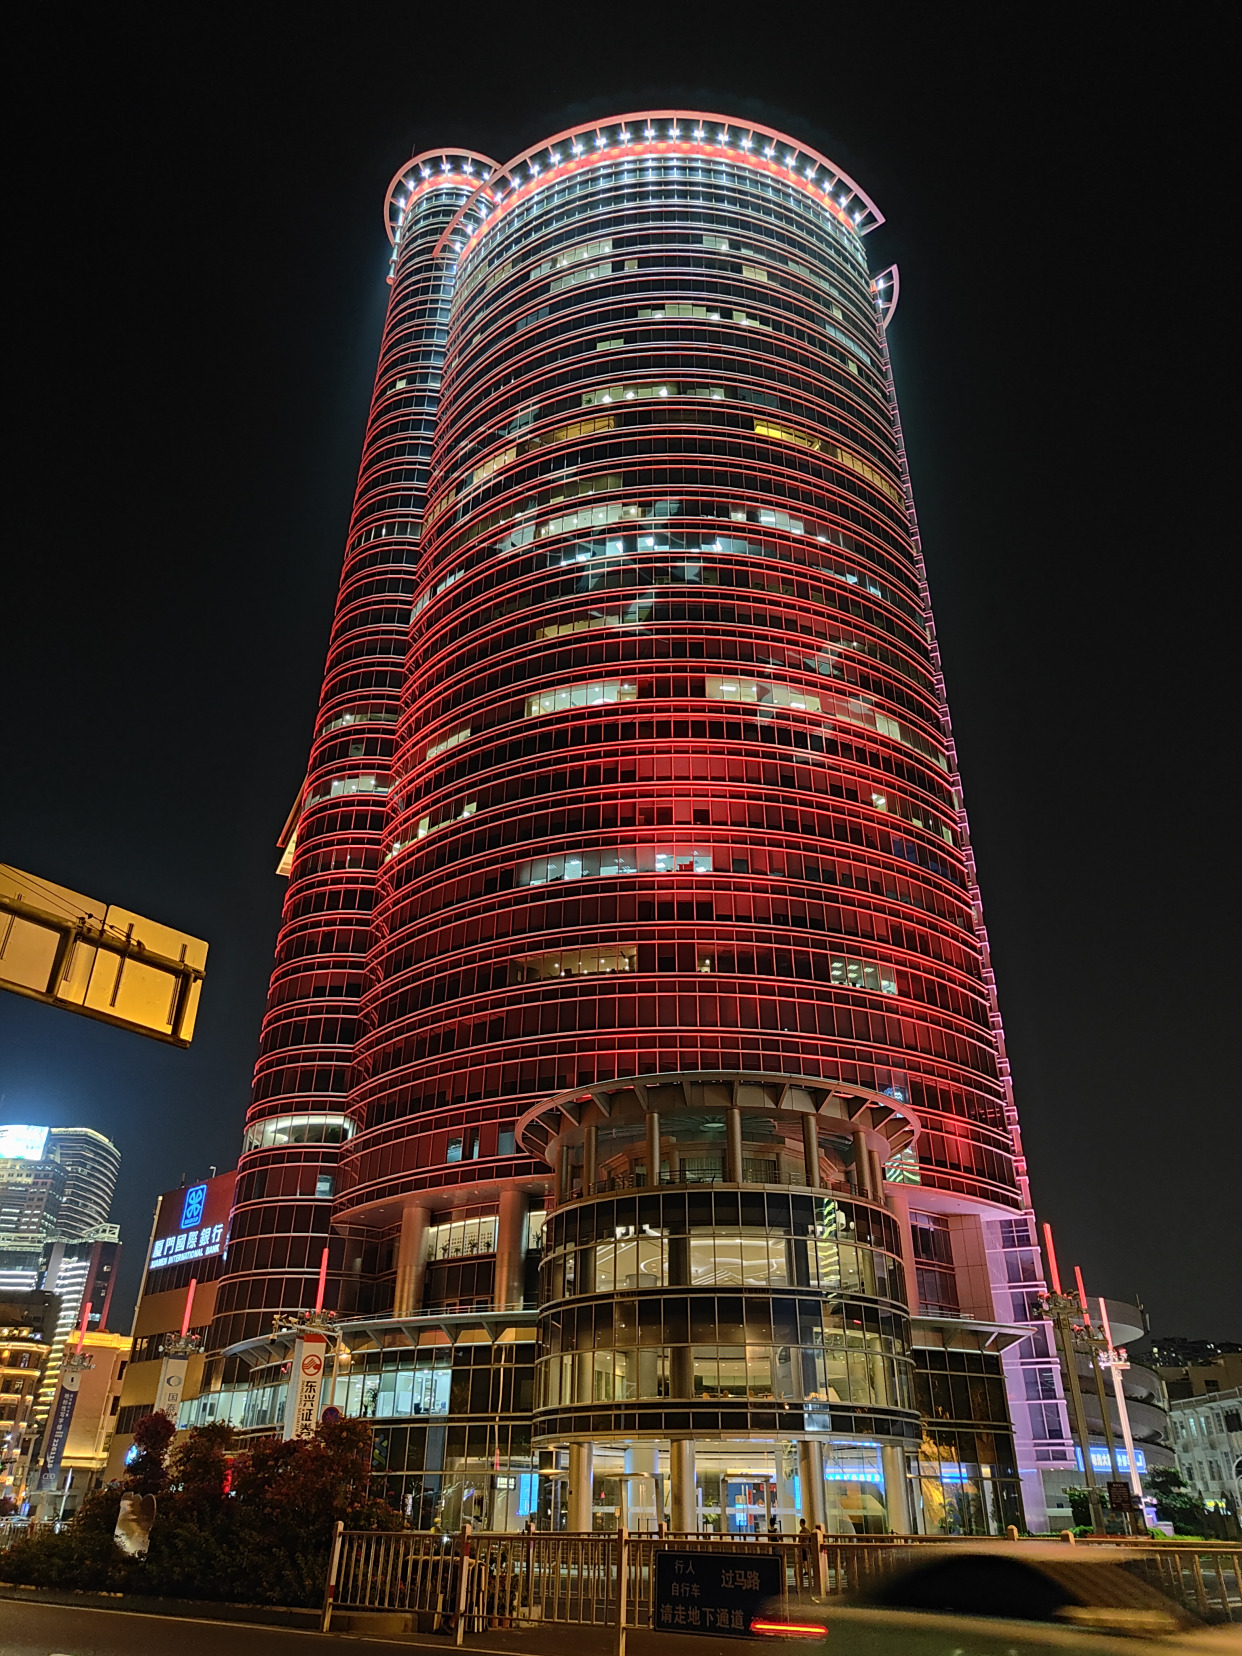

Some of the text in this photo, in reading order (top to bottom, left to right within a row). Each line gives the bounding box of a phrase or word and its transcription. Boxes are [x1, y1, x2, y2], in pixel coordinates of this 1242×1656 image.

[168, 1248, 204, 1265] INTERNATIONAL
[205, 1244, 220, 1256] BANK
[300, 1380, 317, 1436] 东兴证券
[674, 1560, 696, 1575] 行人
[671, 1581, 701, 1598] 自行车
[721, 1569, 760, 1591] 过马路
[660, 1603, 745, 1630] 请走地下通道
